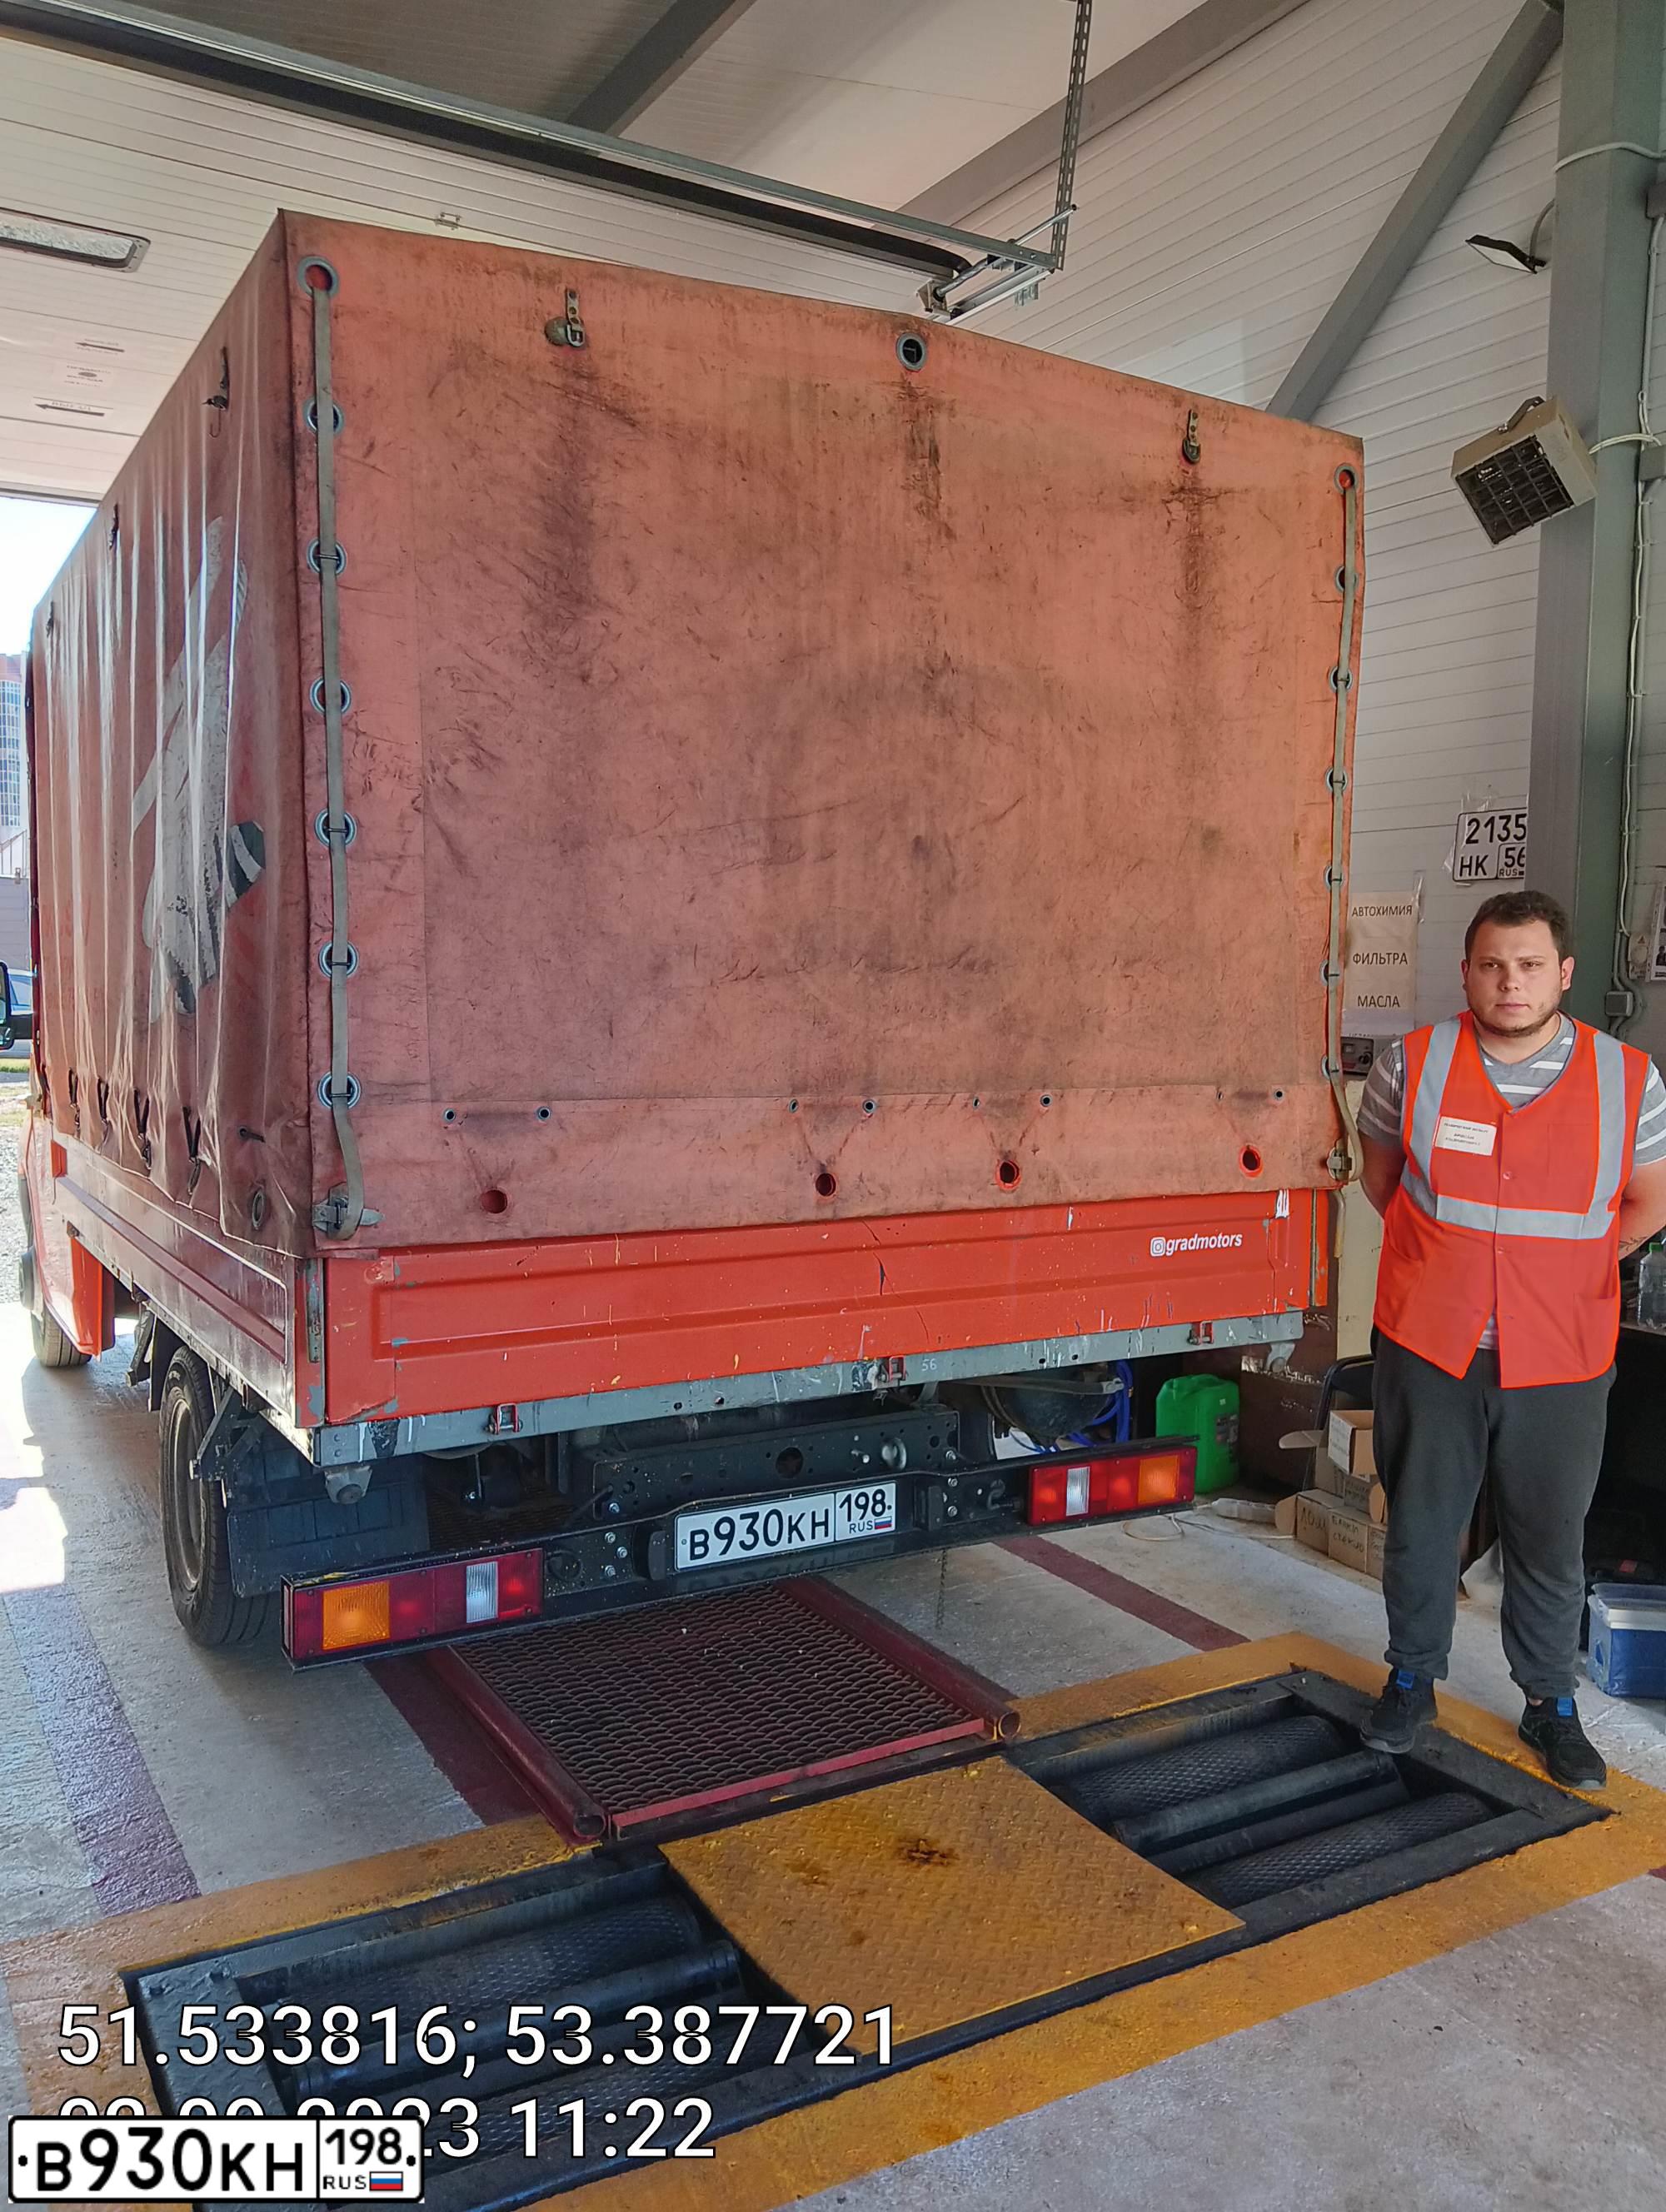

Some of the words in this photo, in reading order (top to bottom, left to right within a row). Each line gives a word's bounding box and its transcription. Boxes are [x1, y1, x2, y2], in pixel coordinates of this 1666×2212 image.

[1465, 813, 1527, 844] 2135
[1499, 868, 1518, 877] RUS
[1351, 904, 1413, 917] АВТОХИМИЯ
[1352, 952, 1408, 965] ФИЛЬТРА
[1357, 995, 1400, 1008] МАСЛА
[839, 1489, 886, 1523] 198
[849, 1520, 874, 1534] RUS
